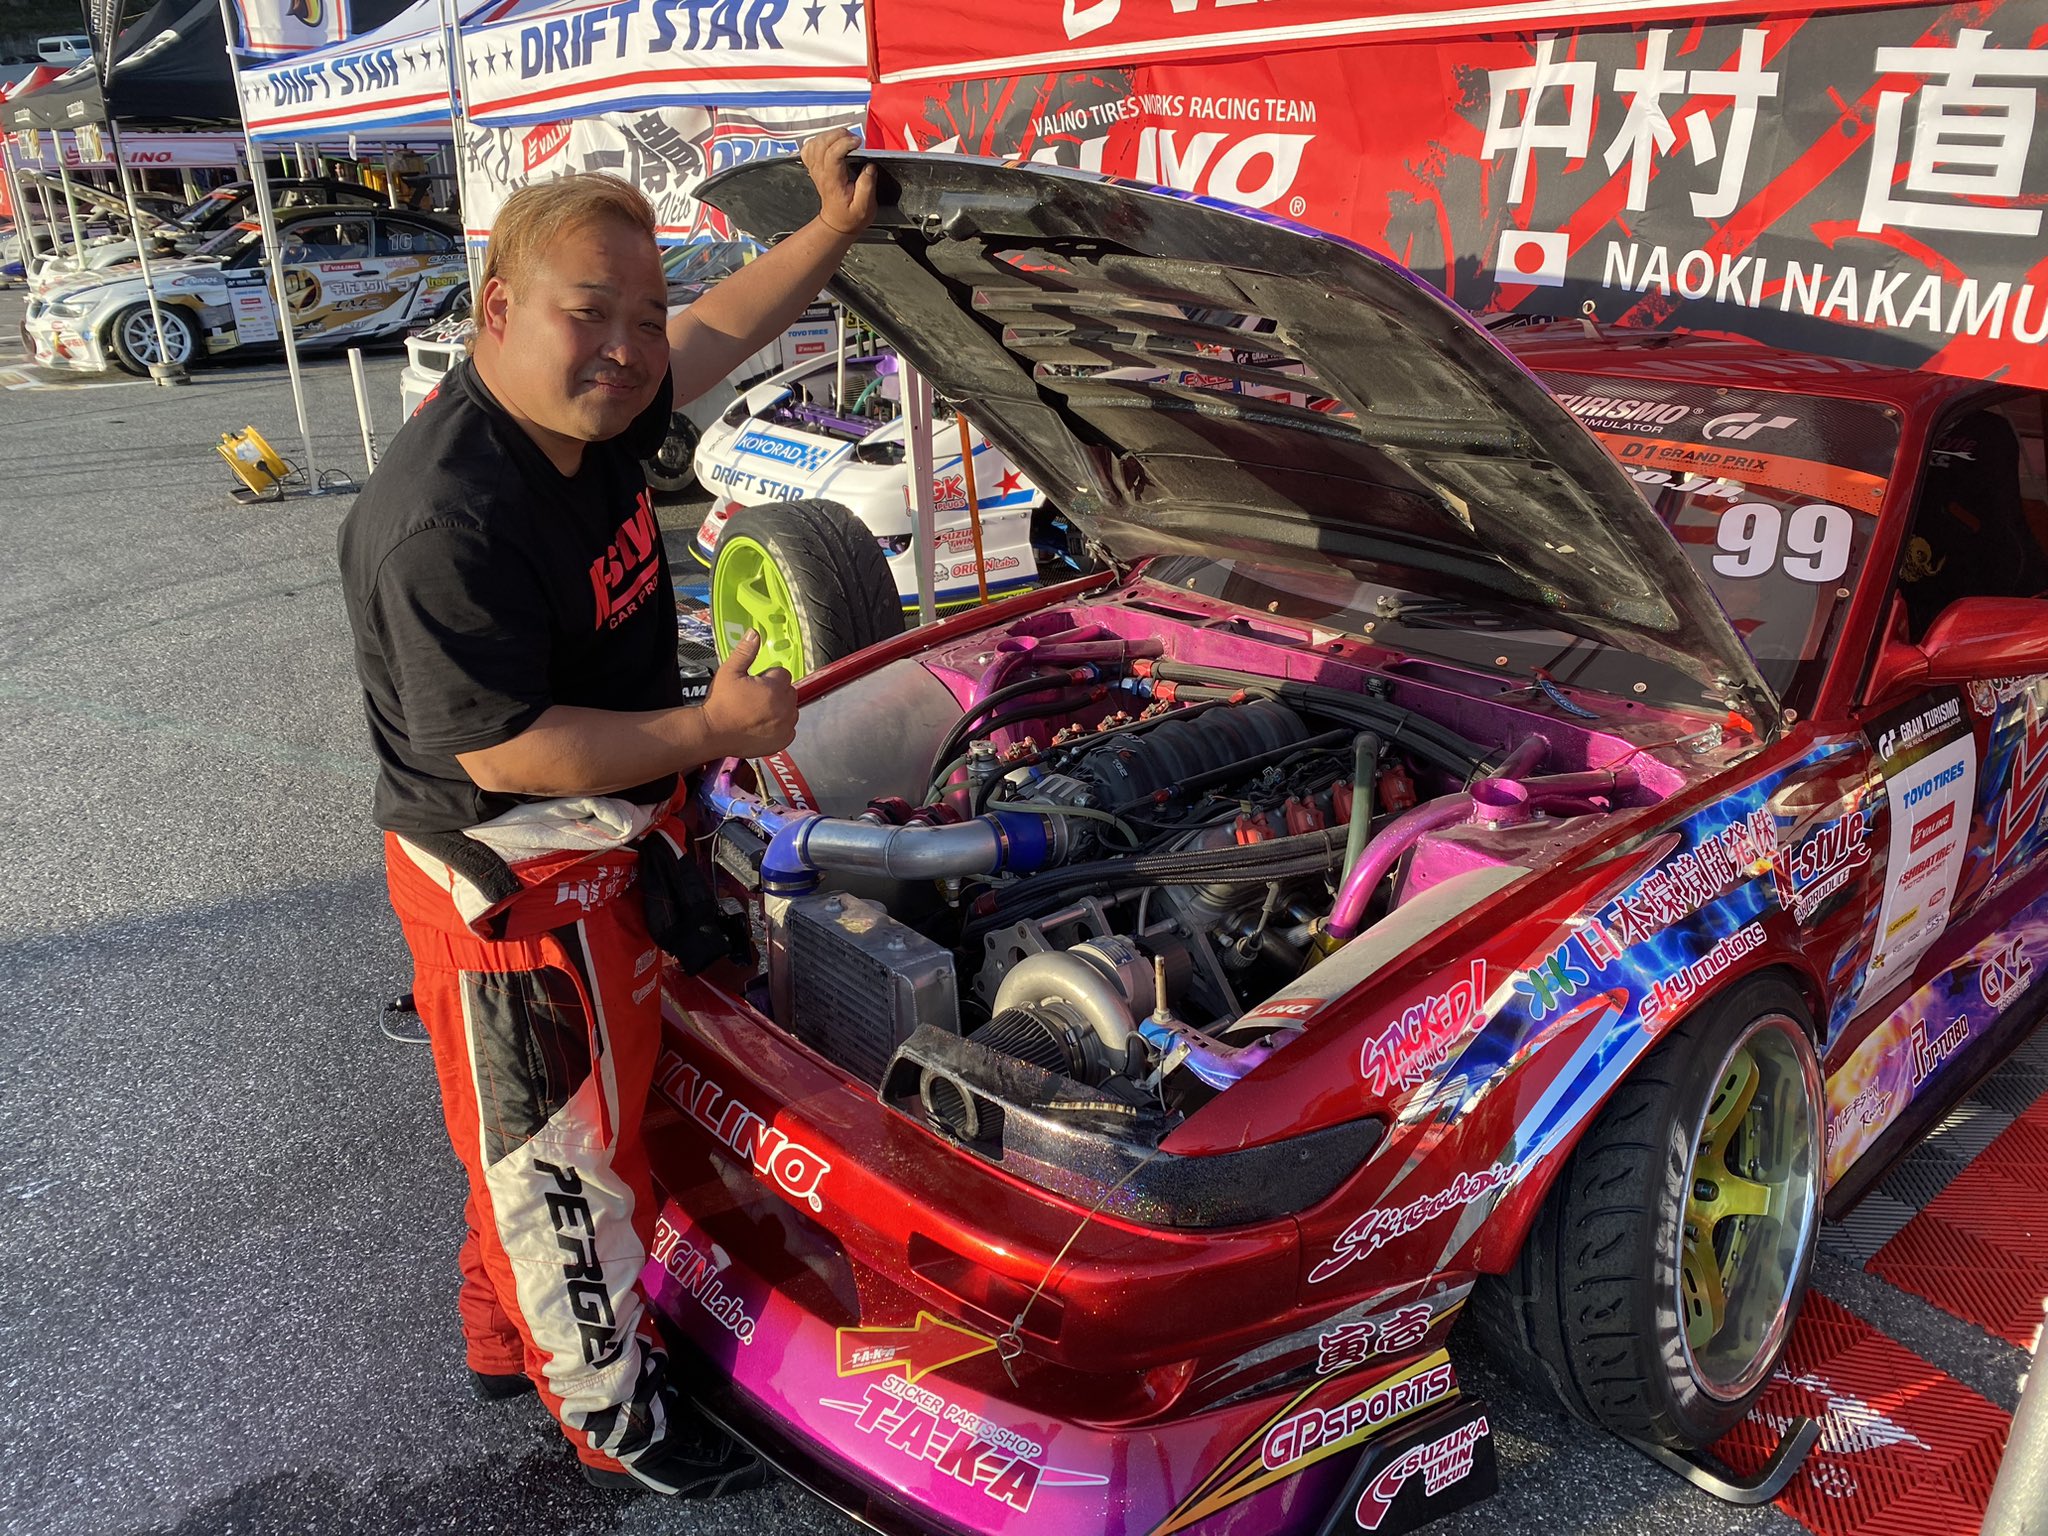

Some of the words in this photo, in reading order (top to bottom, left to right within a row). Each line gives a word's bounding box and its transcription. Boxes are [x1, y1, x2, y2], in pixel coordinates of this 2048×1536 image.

[521, 0, 638, 80] DRIFT
[649, 0, 785, 54] STAR
[271, 63, 326, 107] DRIFT
[331, 48, 400, 97] STAR
[1032, 106, 1089, 137] VALINO
[1090, 96, 1140, 124] TIRES
[1139, 94, 1185, 118] WORKS
[1188, 95, 1261, 122] RACING
[1264, 97, 1317, 124] TEAM
[1480, 28, 1779, 218] 中村
[1856, 27, 2048, 236] 直
[538, 121, 574, 155] VALIN
[388, 233, 413, 251] 16
[1602, 240, 1770, 308] NAOKI
[1779, 260, 2048, 345] NAKAMU
[1557, 394, 1691, 425] TURISMO
[738, 434, 803, 460] KOYORAD
[1621, 442, 1658, 460] D1
[1658, 447, 1721, 465] GRAND
[1721, 455, 1769, 470] PRIX
[711, 464, 757, 491] DRIFT
[756, 478, 805, 502] STAR
[937, 500, 965, 511] PLUGS
[1712, 503, 1854, 582] 99
[951, 558, 995, 578] ORIGN
[609, 602, 638, 630] CAR
[1900, 715, 1925, 742] GRAN
[1922, 698, 1960, 730] TURISMO
[769, 755, 810, 810] VALINO
[1903, 778, 1933, 809] TOYO
[1933, 760, 1965, 791] TIRES
[1921, 814, 1951, 839] VALINO
[1771, 811, 1864, 912] N-style
[1637, 966, 1696, 1025] sky
[652, 1213, 713, 1299] RIGIN
[882, 1373, 945, 1414] STICKER
[943, 1403, 997, 1440] PARTS
[993, 1427, 1043, 1459] SHOP
[1403, 1416, 1489, 1475] SUZUKA
[1425, 1443, 1475, 1483] TWIN
[1425, 1459, 1474, 1498] CIRCUIT
